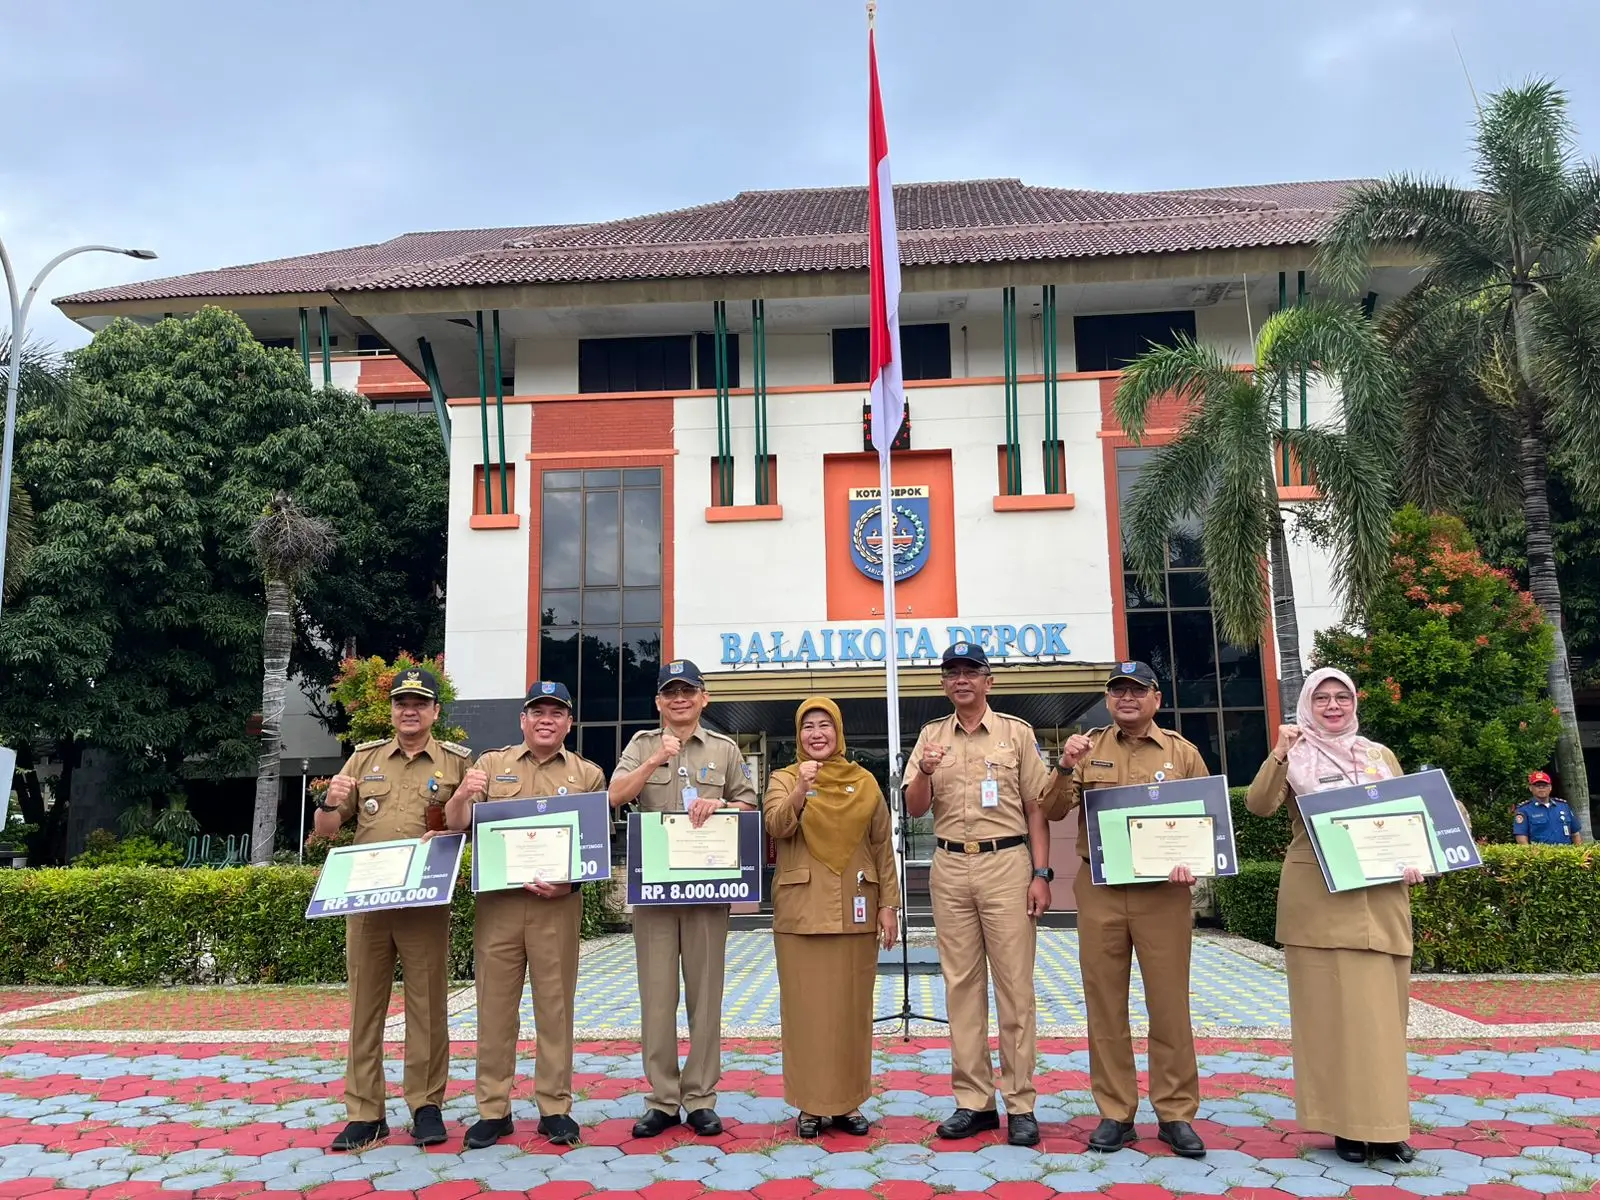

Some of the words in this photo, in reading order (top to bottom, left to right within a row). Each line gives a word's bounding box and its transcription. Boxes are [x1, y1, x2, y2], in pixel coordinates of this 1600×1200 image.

[855, 489, 881, 498] KOTA
[890, 487, 922, 497] DEPOK
[947, 623, 1071, 657] DEPOK
[322, 898, 348, 911] RP.
[353, 886, 438, 907] 3.000.000
[641, 885, 666, 900] RP.
[670, 883, 749, 899] 8.000.000
